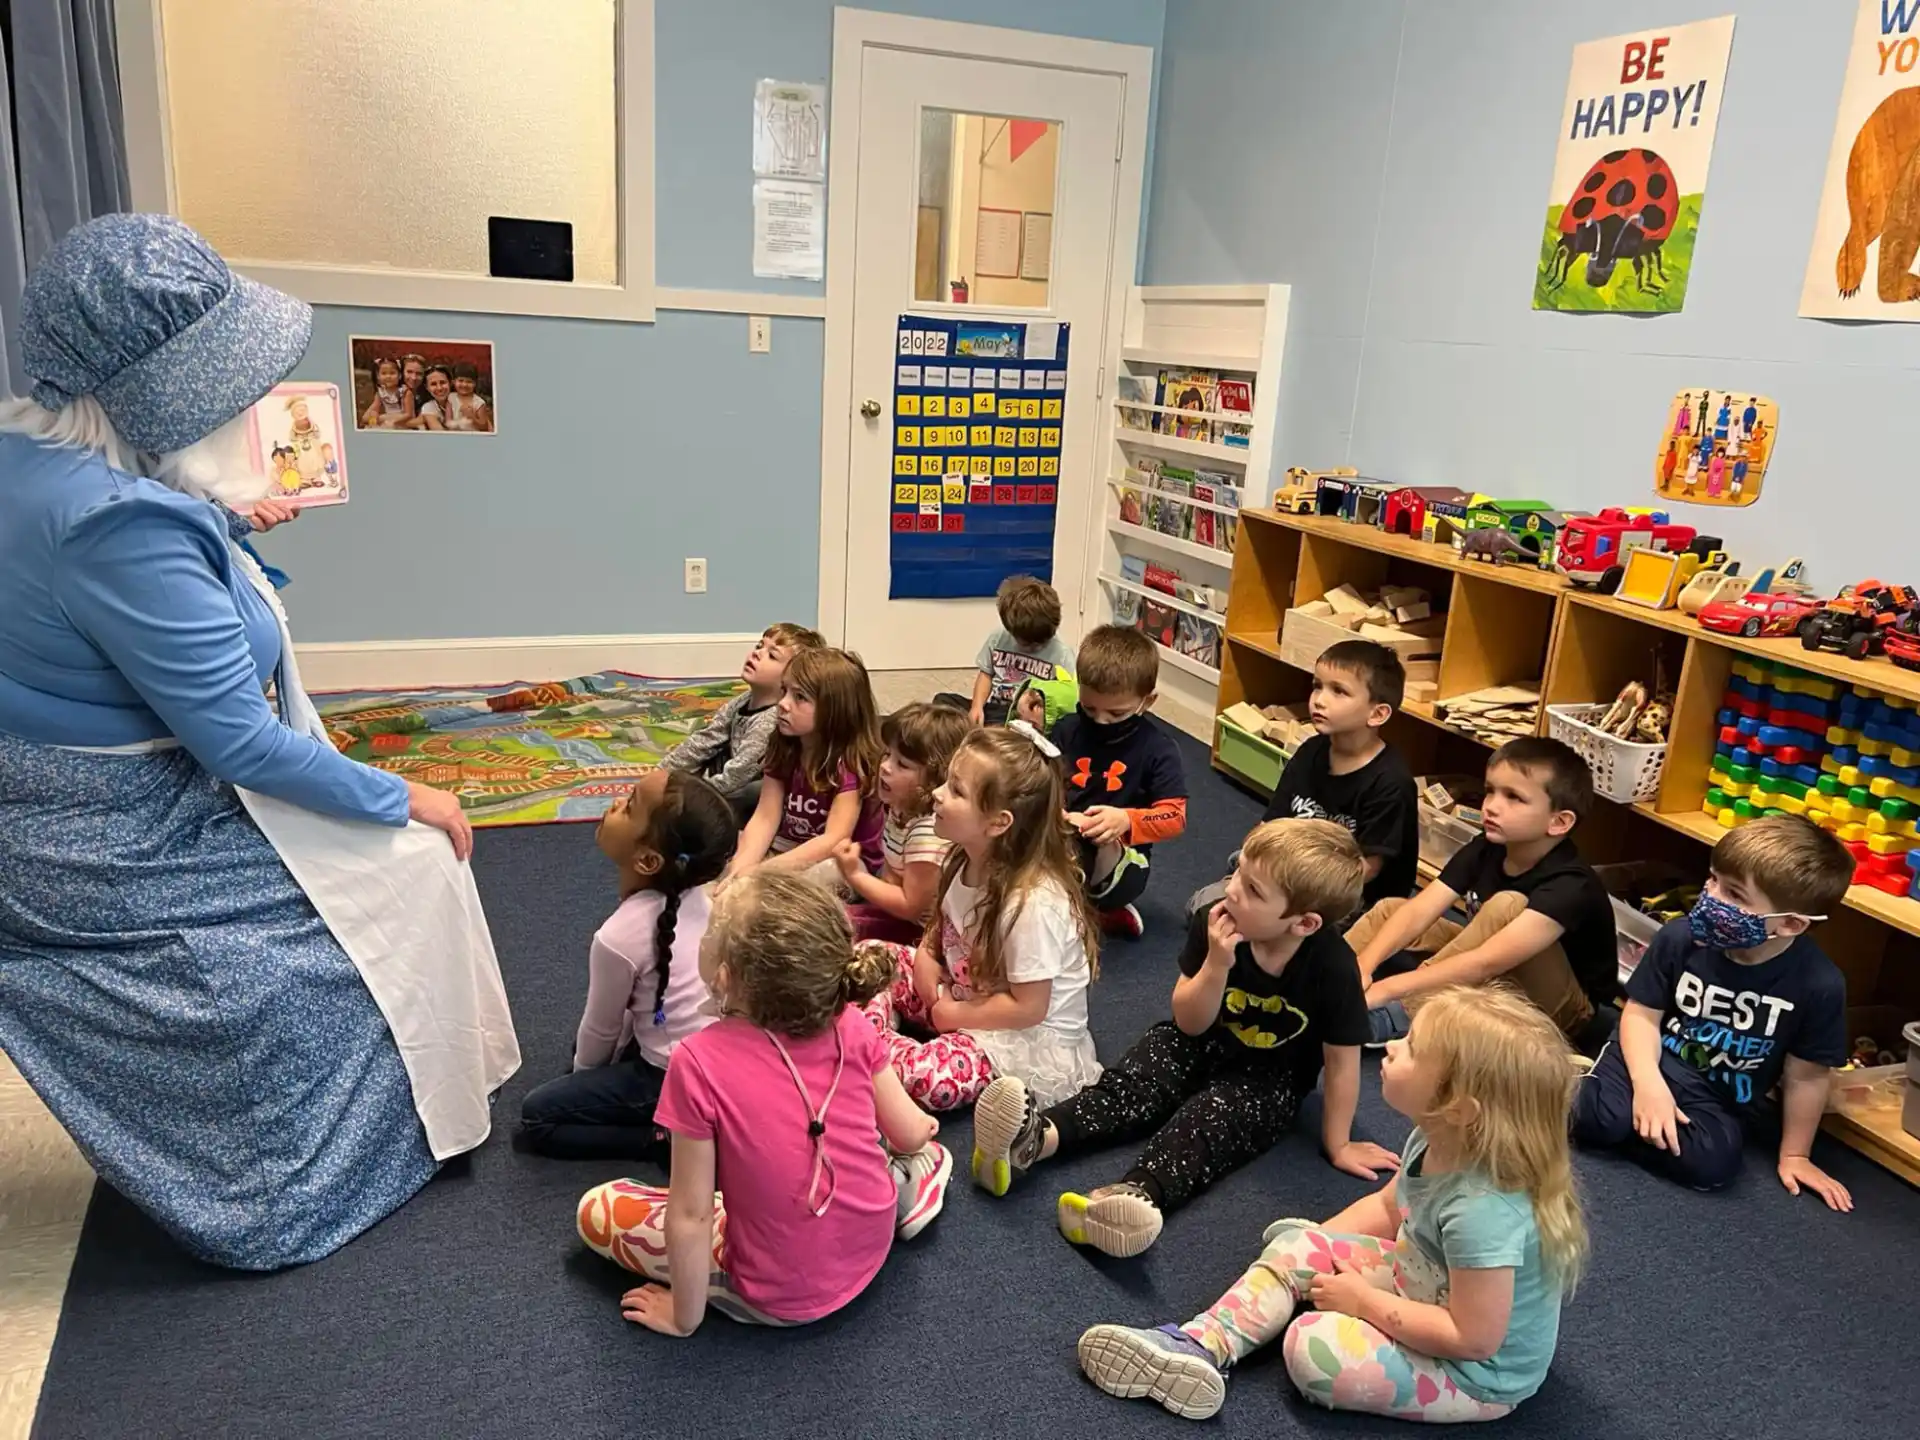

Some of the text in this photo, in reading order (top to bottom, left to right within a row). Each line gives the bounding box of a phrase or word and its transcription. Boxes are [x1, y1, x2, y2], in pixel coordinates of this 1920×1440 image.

[1620, 37, 1671, 84] BE
[1570, 80, 1707, 140] HAPPY!
[973, 336, 1001, 351] May
[930, 400, 938, 413] 2
[955, 402, 963, 414] 3
[980, 398, 989, 409] 4
[1005, 403, 1013, 414] 5
[1026, 404, 1034, 415] 6
[1049, 403, 1056, 414] 7
[904, 430, 1056, 443] 8 9 10 11 12 13 14
[899, 460, 1055, 472] 15 16 17 18 19 20 21
[898, 488, 914, 499] 22
[923, 489, 938, 500] 23
[948, 488, 962, 499] 24
[998, 489, 1011, 499] 26
[1019, 489, 1032, 499] 27
[1040, 489, 1053, 499] 28
[896, 518, 960, 529] 29 30 31
[1477, 514, 1499, 523] SCHOOL
[992, 650, 1052, 679] PLAYTIME
[1675, 971, 1795, 1037] BEST
[1682, 1020, 1776, 1058] OTHER
